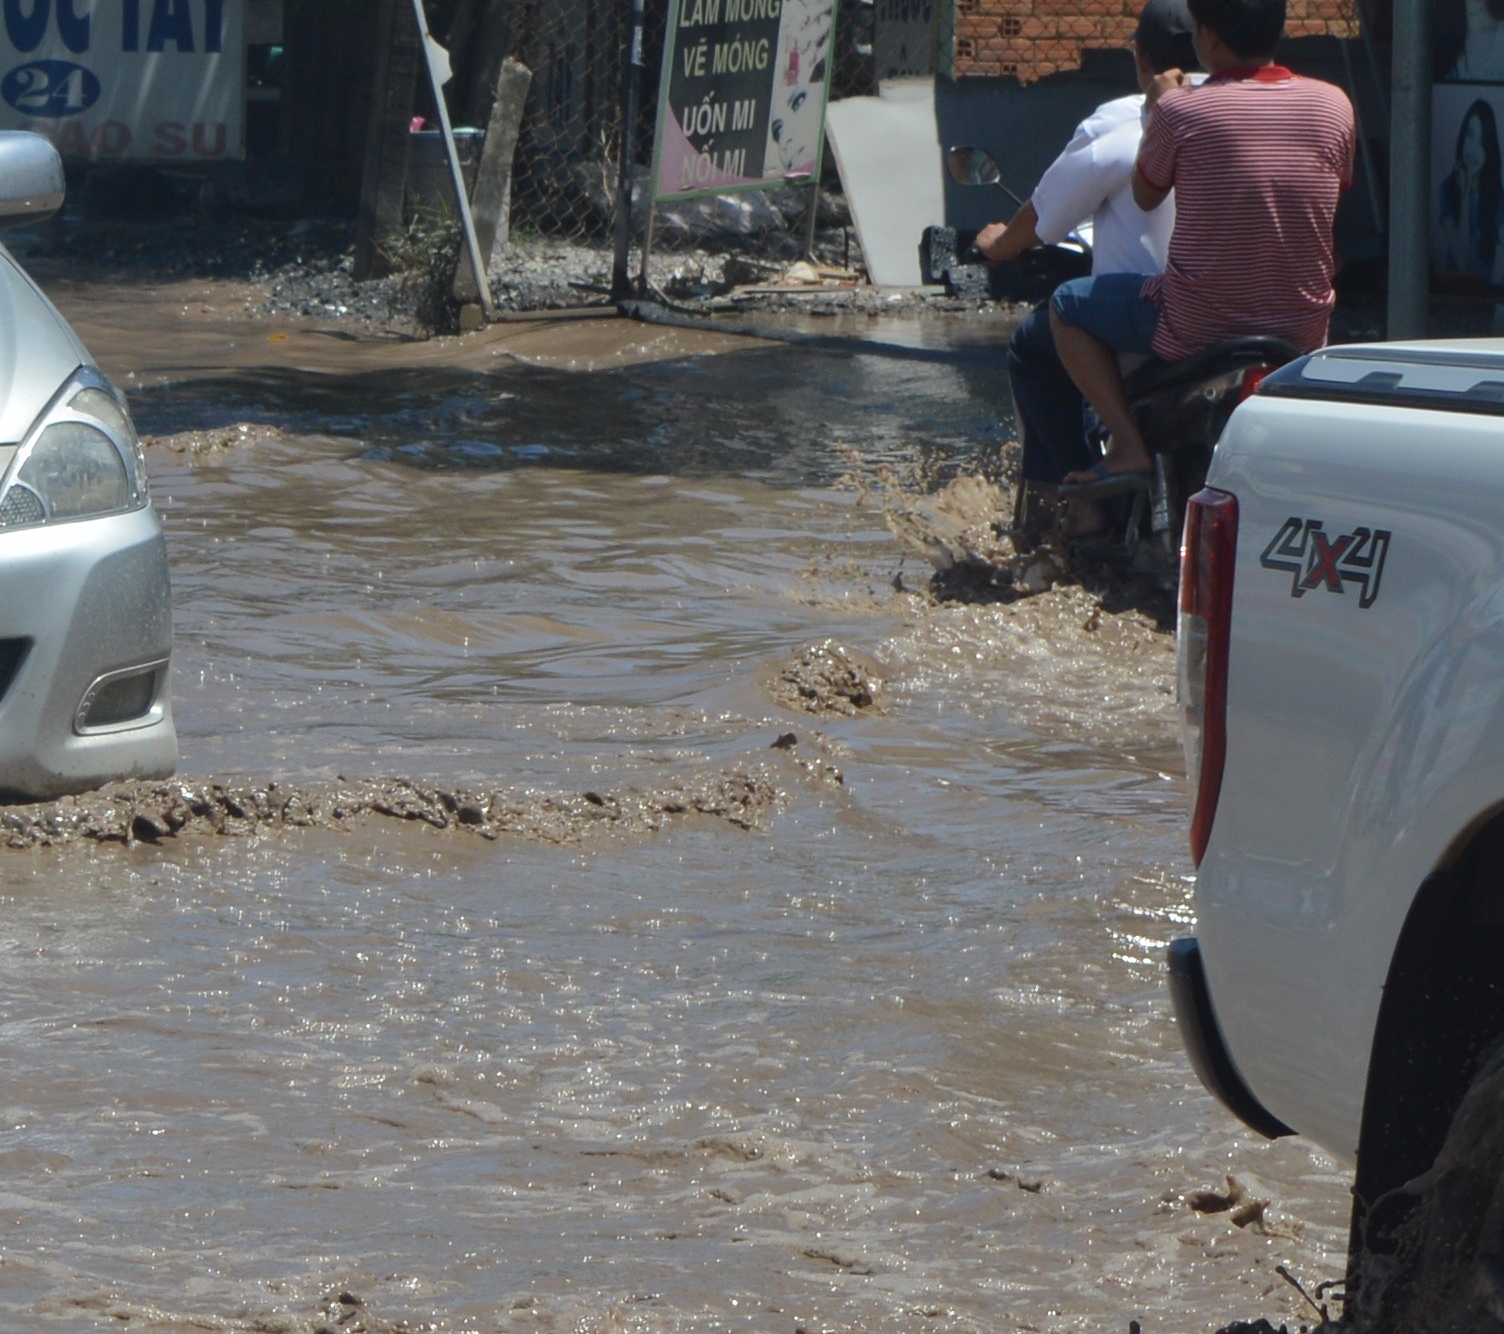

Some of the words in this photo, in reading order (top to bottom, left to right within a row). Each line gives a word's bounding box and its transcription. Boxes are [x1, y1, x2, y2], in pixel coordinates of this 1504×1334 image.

[683, 40, 707, 78] VẼ
[712, 33, 769, 76] MÓNG
[15, 68, 89, 107] 24
[681, 89, 726, 138] UỐN
[731, 98, 756, 131] MI
[152, 121, 229, 156] SU
[680, 142, 718, 185] NỐI
[723, 148, 746, 178] MI
[1260, 517, 1392, 609] 4x4
